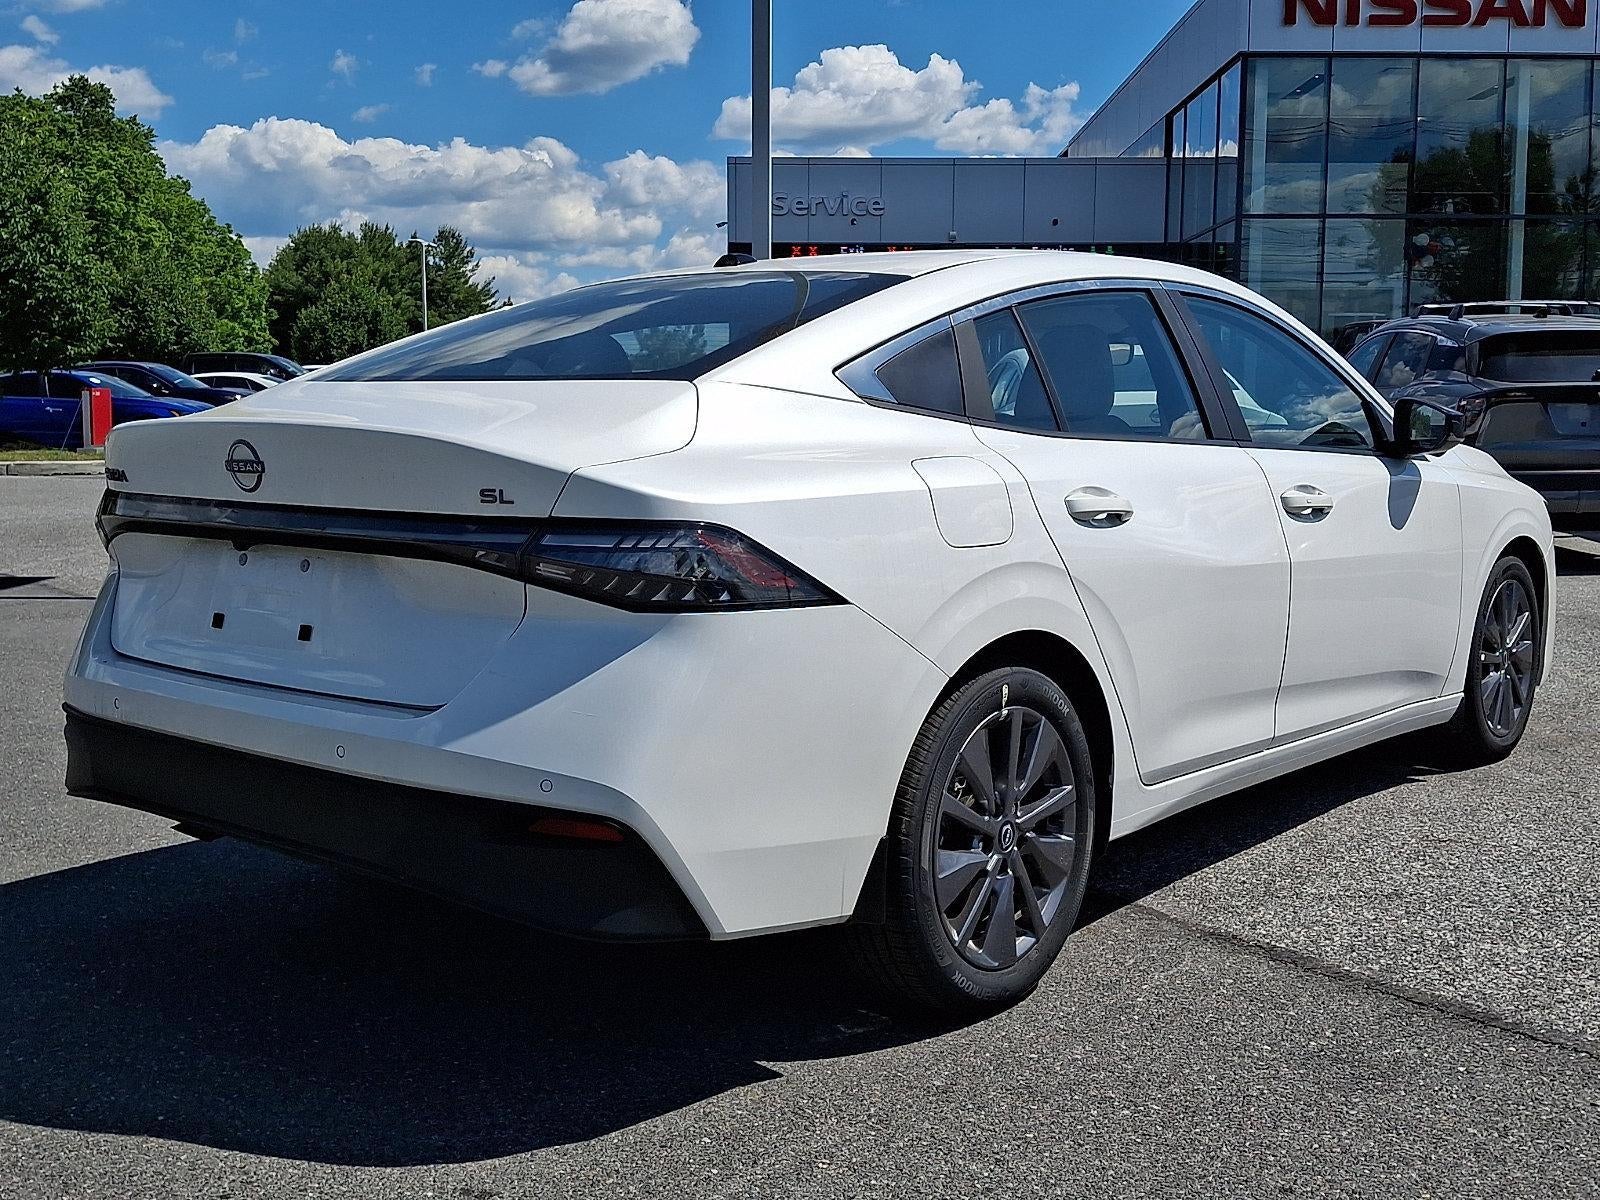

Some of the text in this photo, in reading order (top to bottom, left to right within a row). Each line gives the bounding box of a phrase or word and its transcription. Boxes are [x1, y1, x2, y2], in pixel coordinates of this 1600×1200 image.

[1283, 0, 1587, 27] NISSAN
[772, 190, 885, 217] Service
[225, 461, 263, 473] NISSAN
[479, 488, 515, 505] SL
